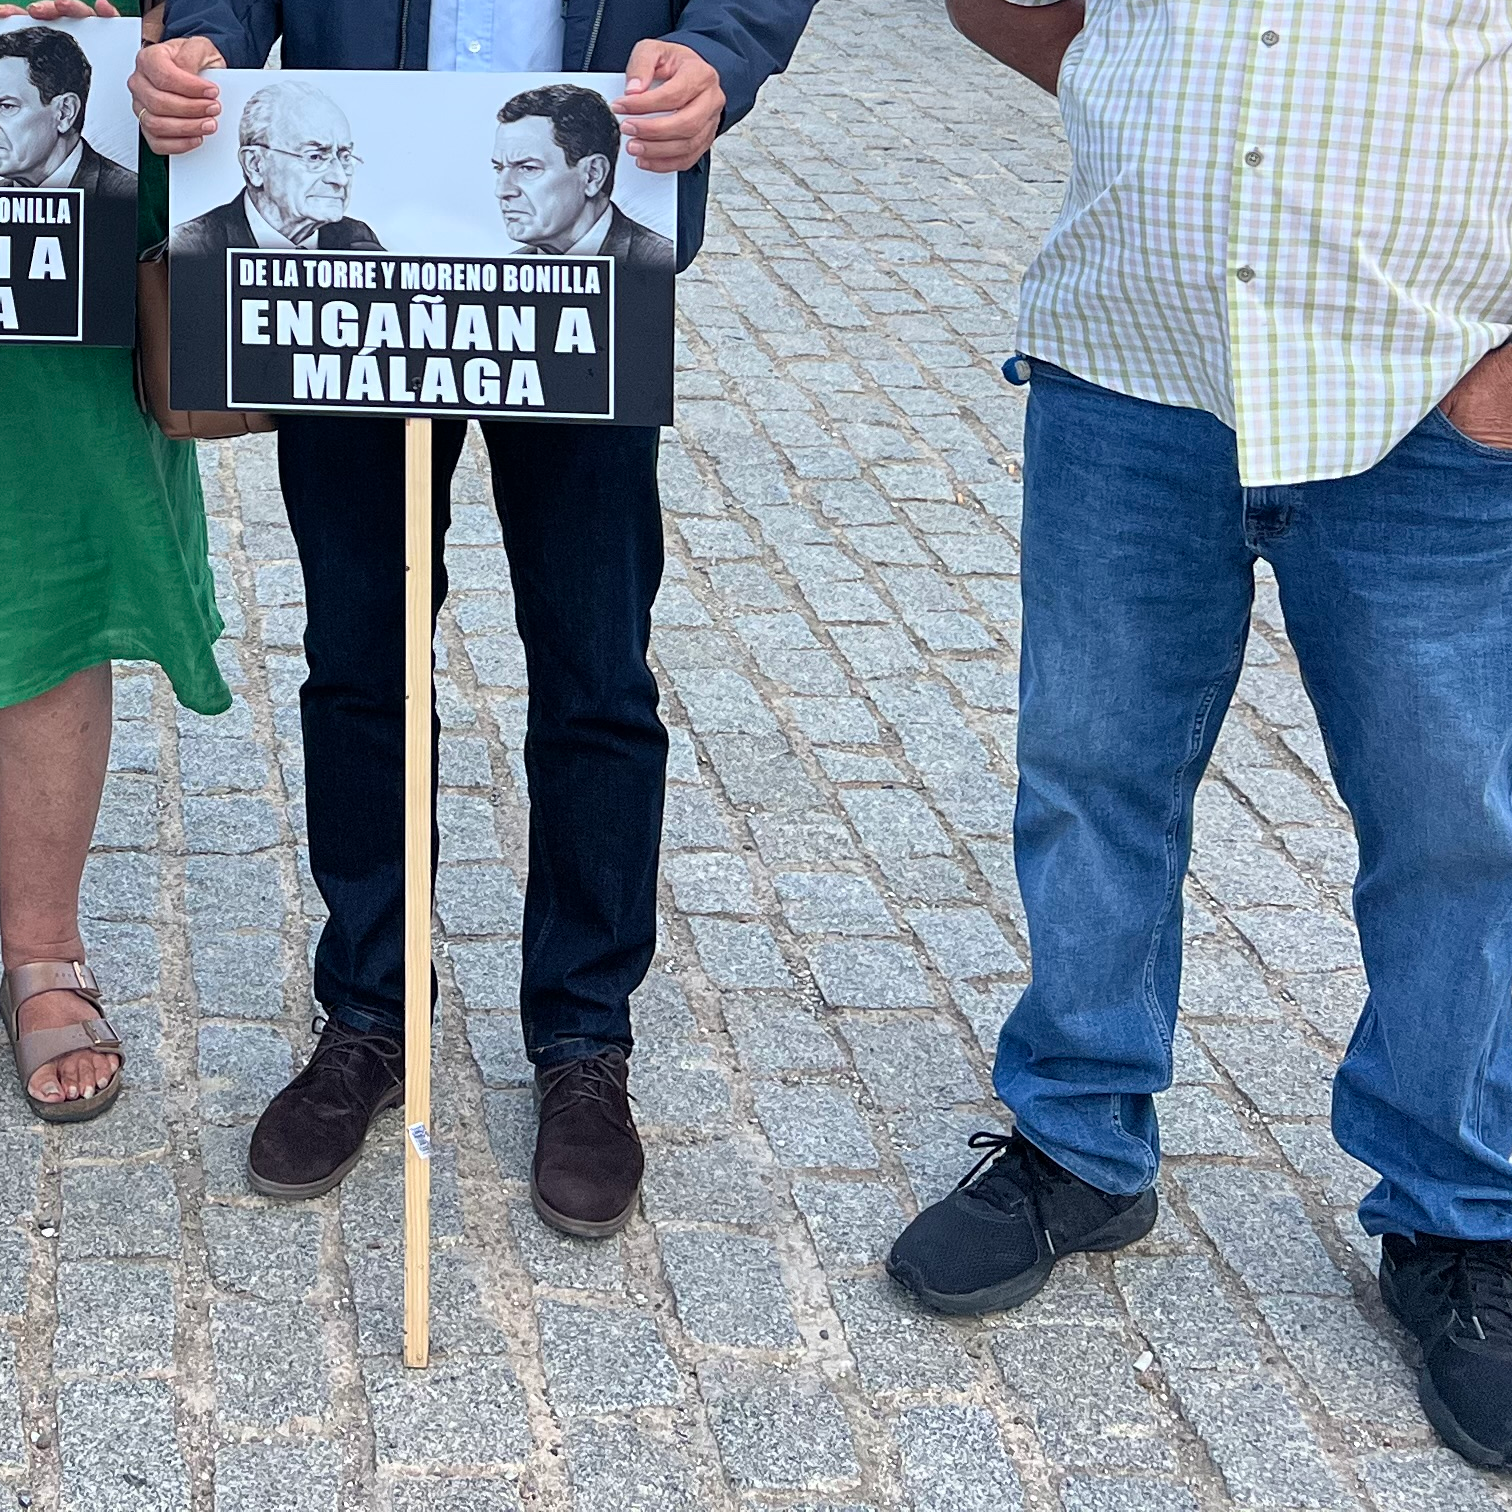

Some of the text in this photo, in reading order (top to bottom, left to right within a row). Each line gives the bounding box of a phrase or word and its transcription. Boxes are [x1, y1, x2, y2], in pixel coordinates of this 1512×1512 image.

[28, 236, 67, 280] A
[239, 258, 601, 294] DE LA TORRE Y MORENO BONILLA
[241, 294, 597, 354] ENGAÑAN A
[292, 346, 545, 406] MÁLAGA
